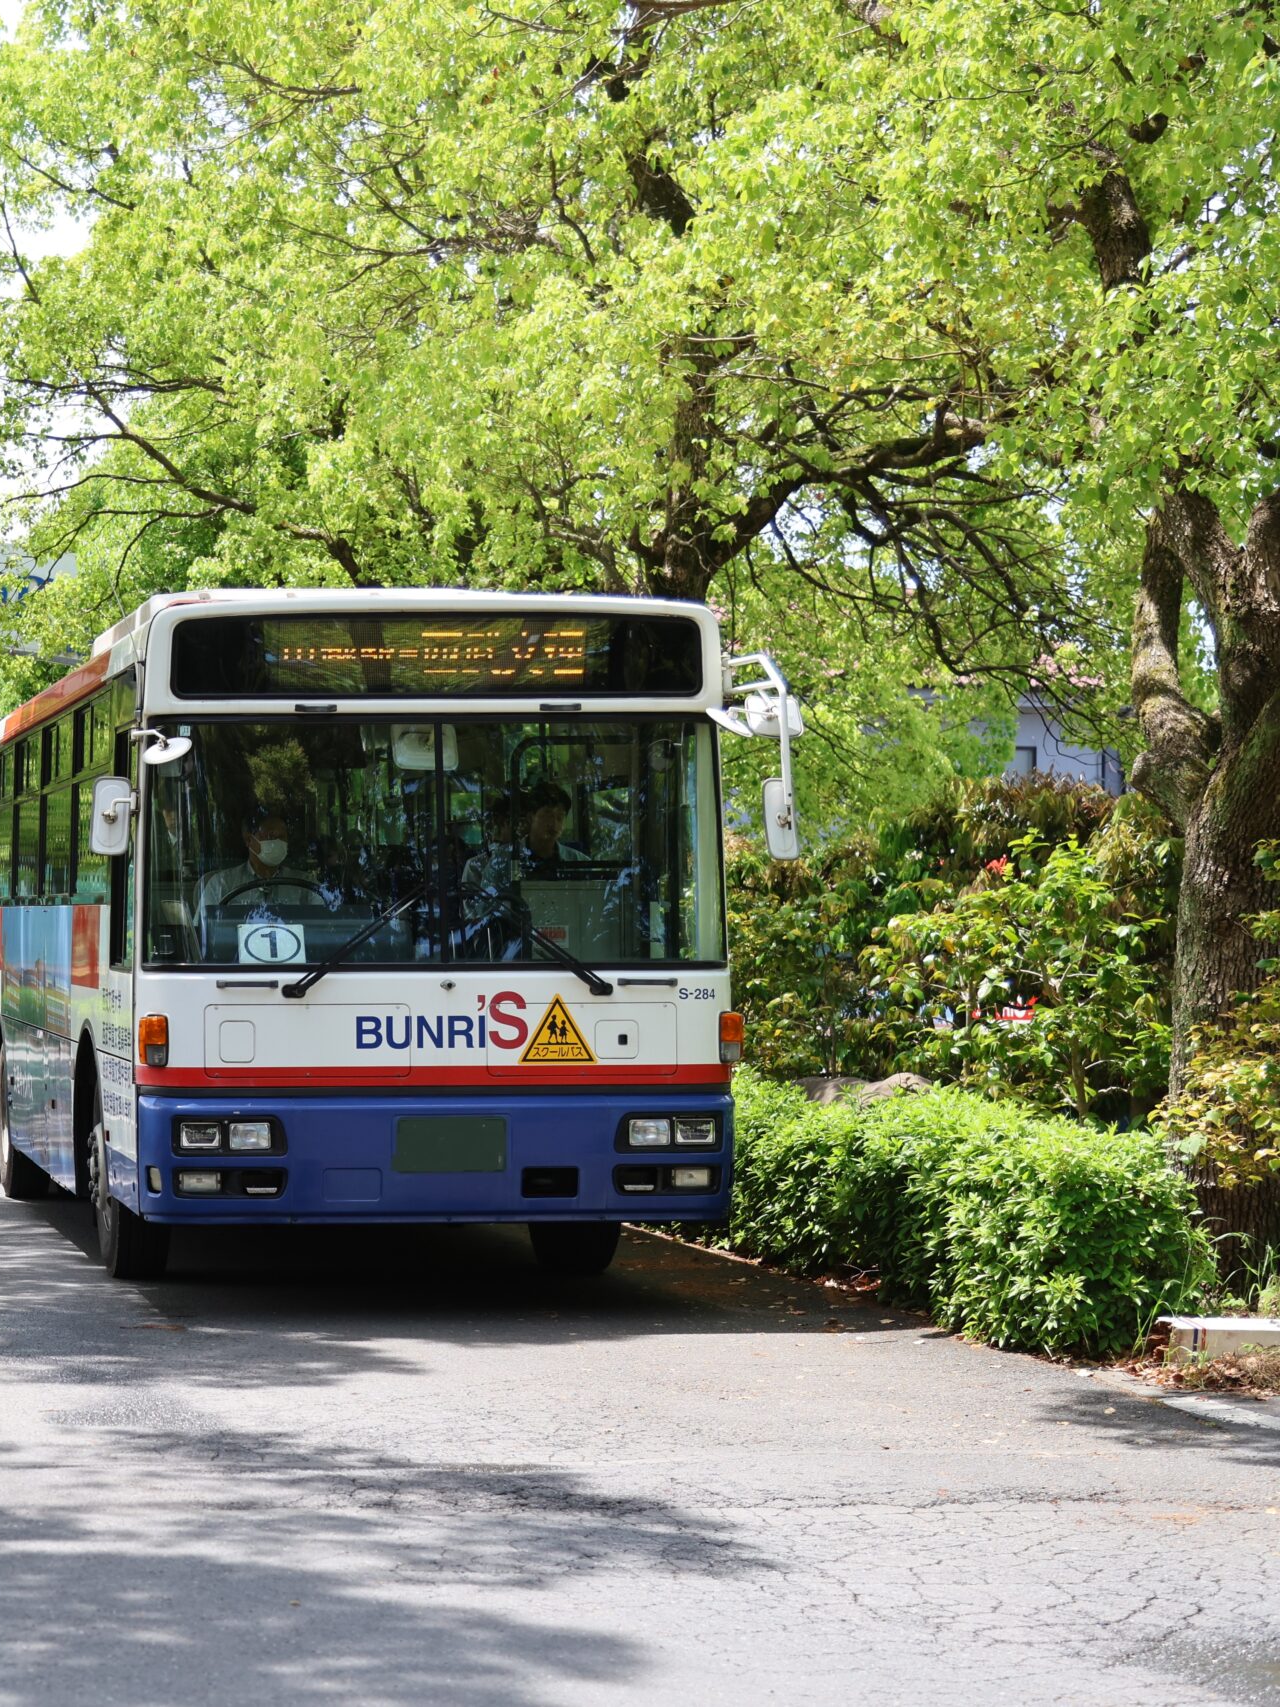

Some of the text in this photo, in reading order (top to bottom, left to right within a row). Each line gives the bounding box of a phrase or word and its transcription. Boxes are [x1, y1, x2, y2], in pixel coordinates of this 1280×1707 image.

[679, 987, 716, 1000] S-284
[533, 1046, 584, 1058] スクールバス
